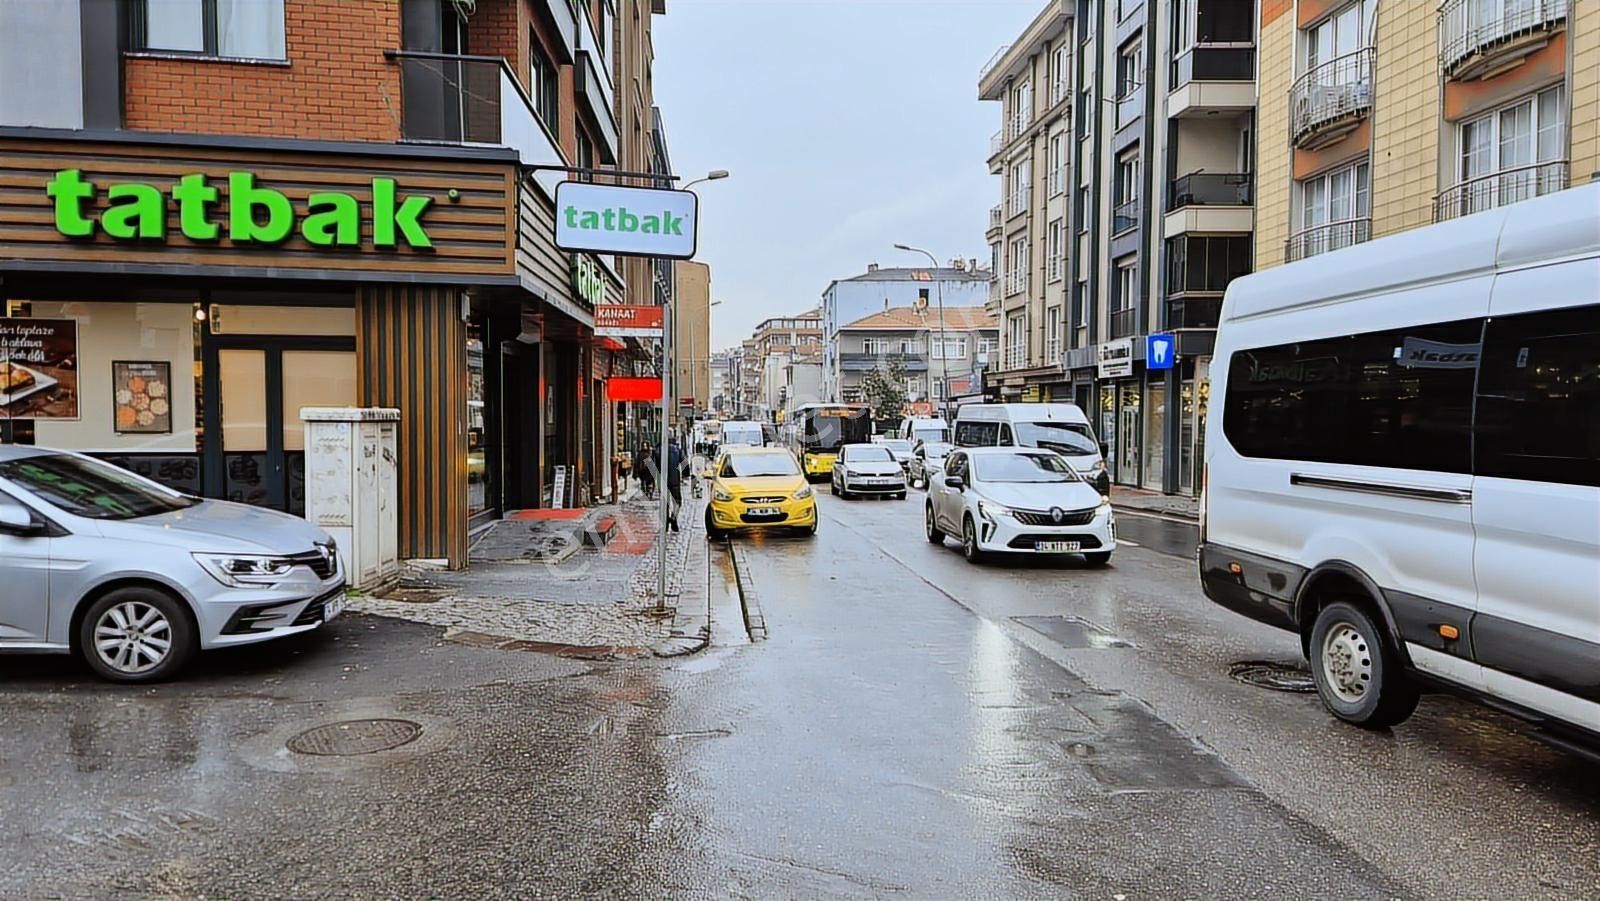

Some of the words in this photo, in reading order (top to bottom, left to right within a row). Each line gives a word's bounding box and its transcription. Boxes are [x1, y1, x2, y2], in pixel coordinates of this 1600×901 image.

[47, 168, 435, 251] tatbak
[564, 205, 683, 235] tatbak
[598, 308, 635, 319] KANAAT
